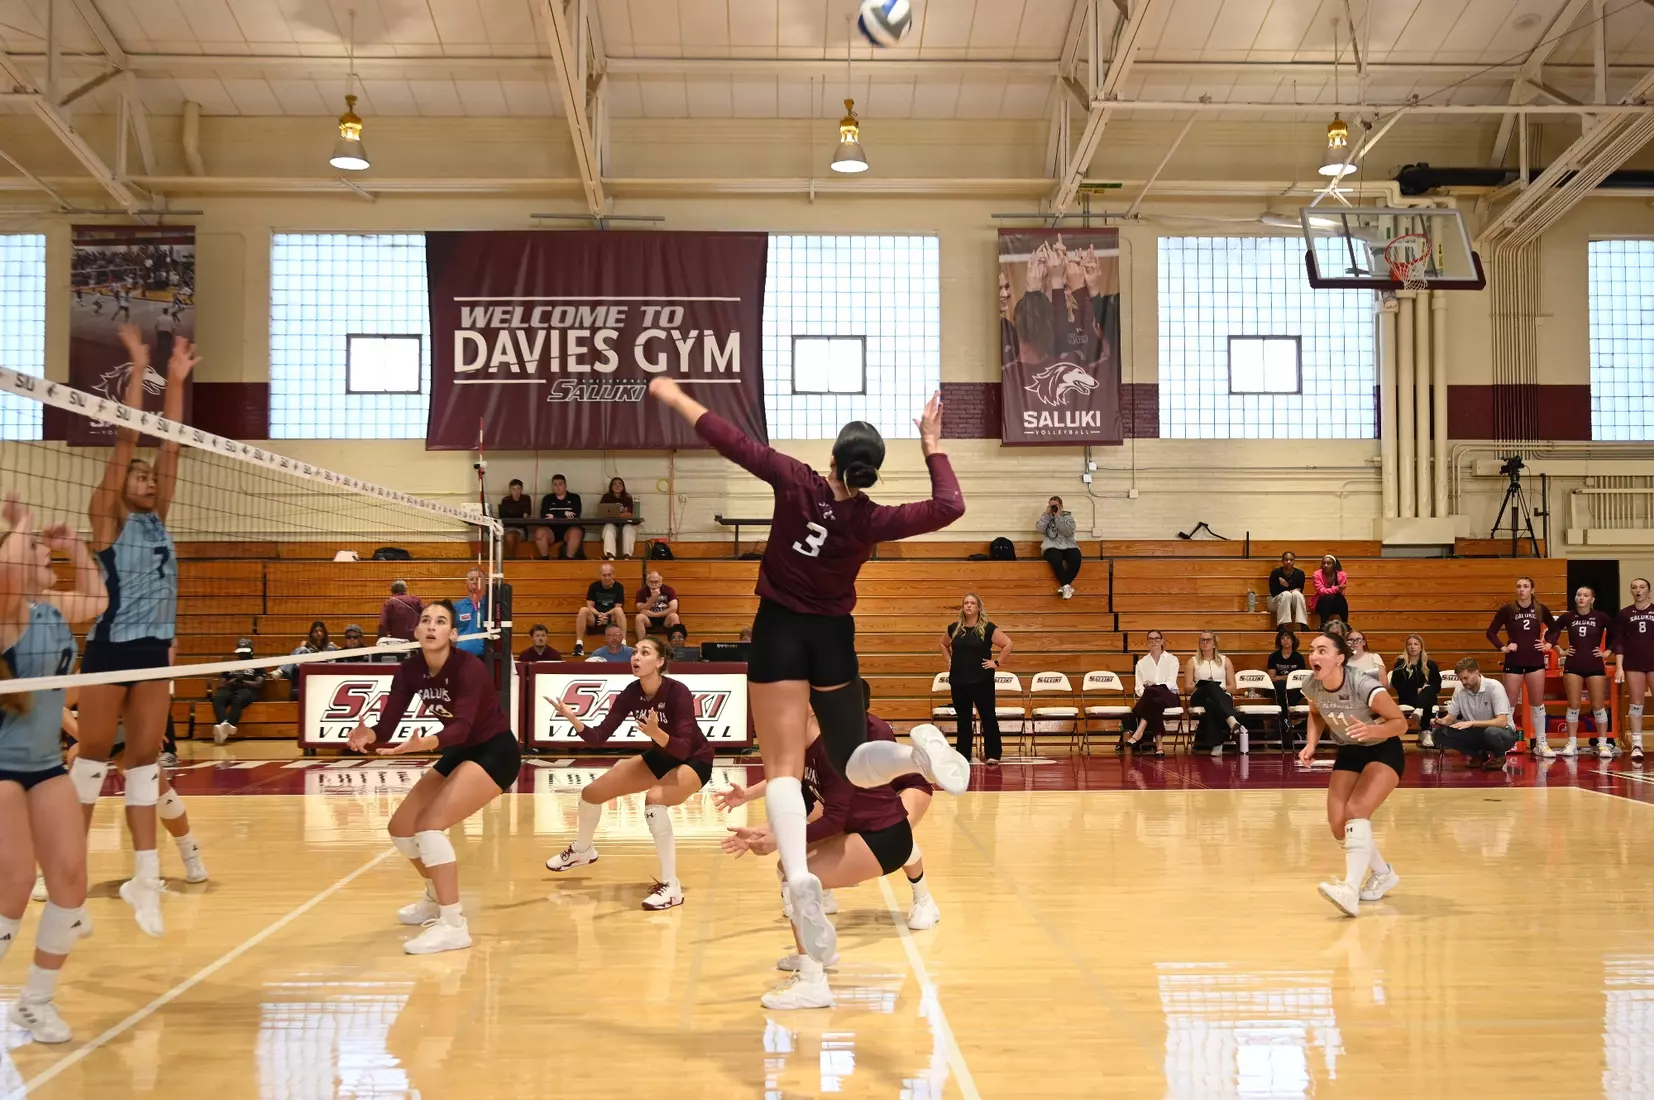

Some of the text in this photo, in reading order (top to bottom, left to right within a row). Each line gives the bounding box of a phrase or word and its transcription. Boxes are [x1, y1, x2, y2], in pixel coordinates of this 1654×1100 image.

[461, 306, 684, 328] WELCOME TO
[454, 329, 741, 374] DAVIES GYM
[546, 379, 647, 401] SALUKI
[1023, 411, 1101, 428] SALUKI
[792, 521, 828, 557] 3
[154, 546, 170, 580] 7
[1523, 619, 1531, 630] 2
[1579, 626, 1587, 637] 9
[1638, 621, 1647, 633] 8
[1328, 711, 1349, 727] 11
